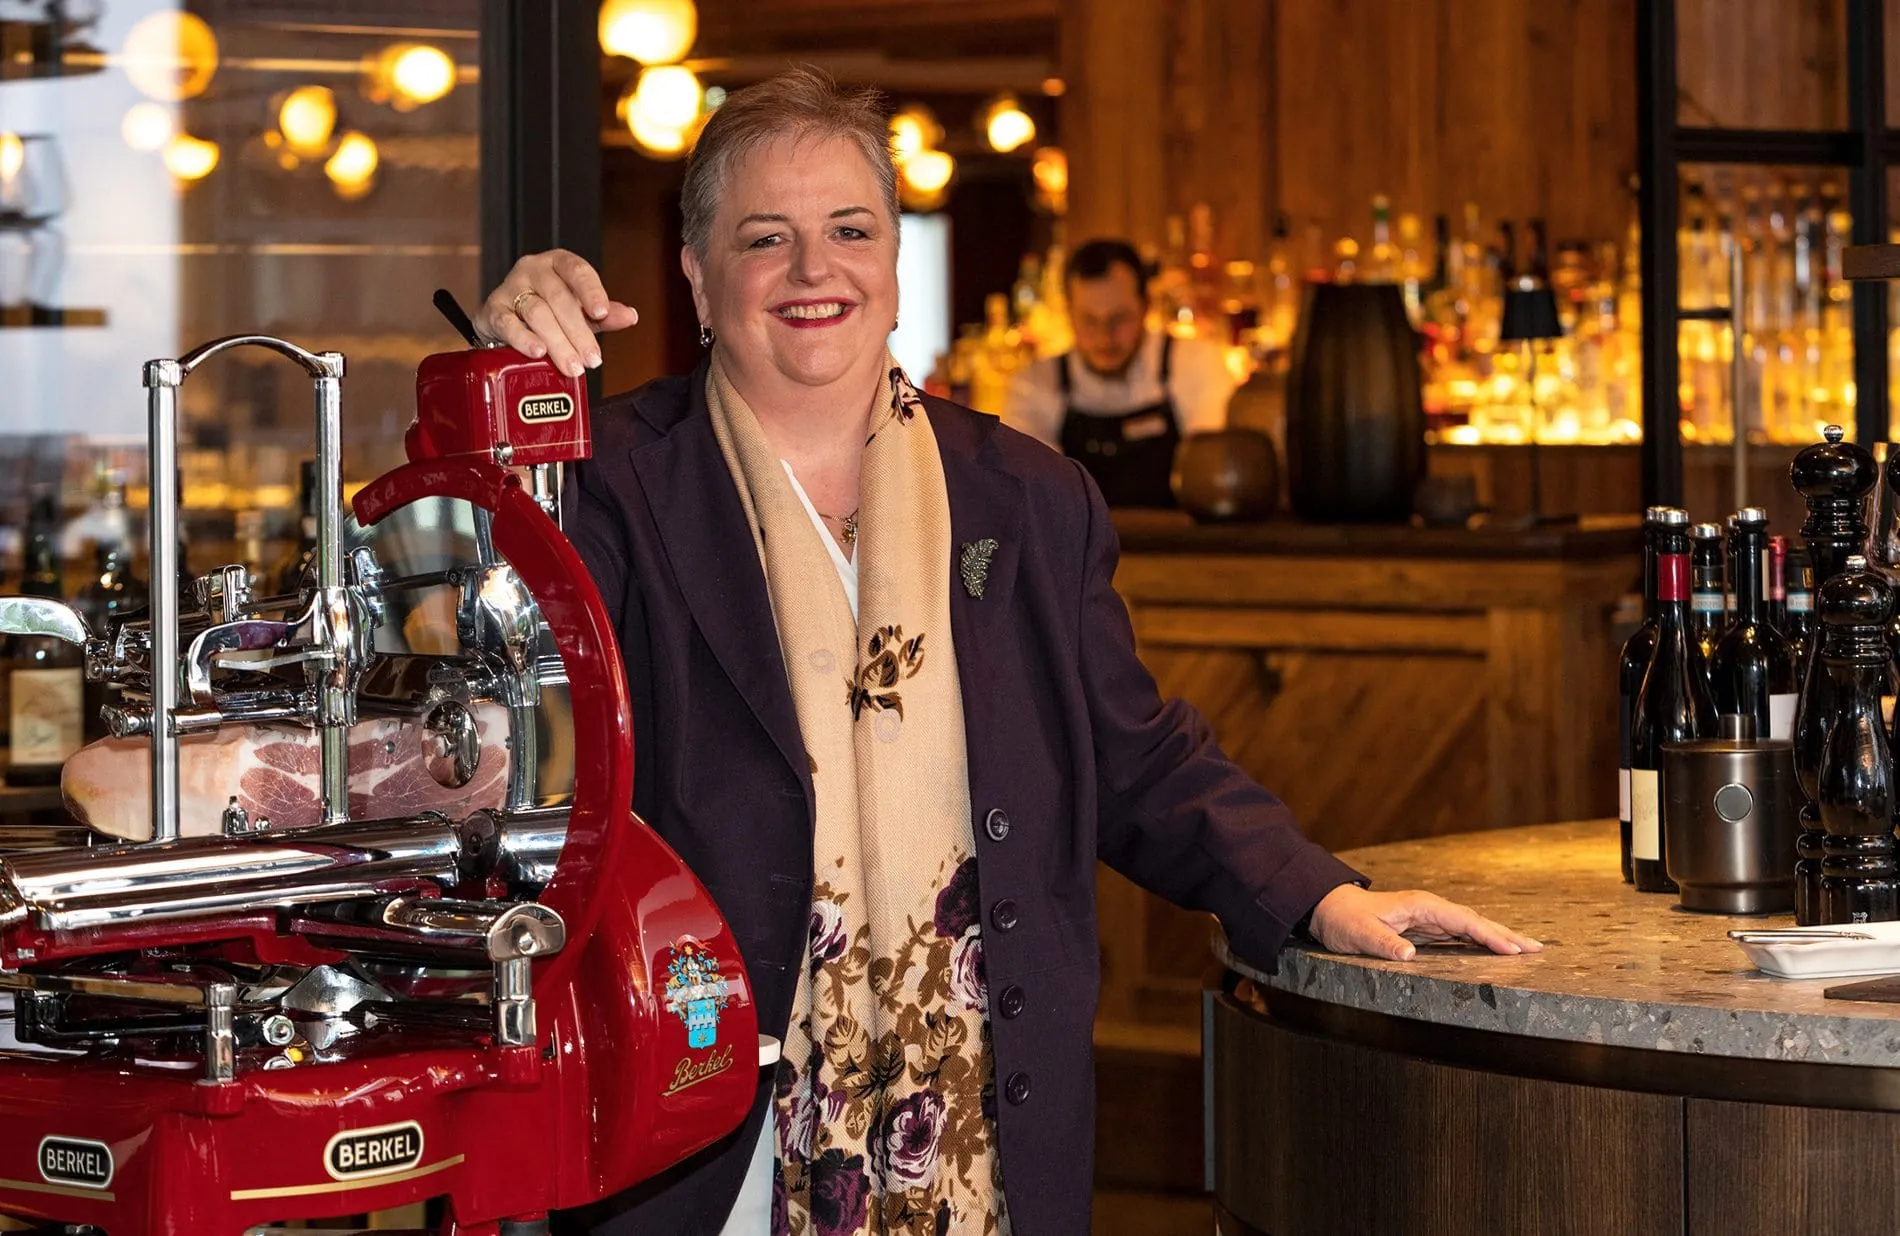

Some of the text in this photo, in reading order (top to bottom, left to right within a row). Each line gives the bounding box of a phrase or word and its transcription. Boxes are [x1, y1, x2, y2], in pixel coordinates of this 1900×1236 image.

[524, 400, 568, 417] BERKEL
[662, 1044, 733, 1096] Berkel
[46, 1148, 106, 1176] BERKEL
[339, 1134, 416, 1168] BERKEL
